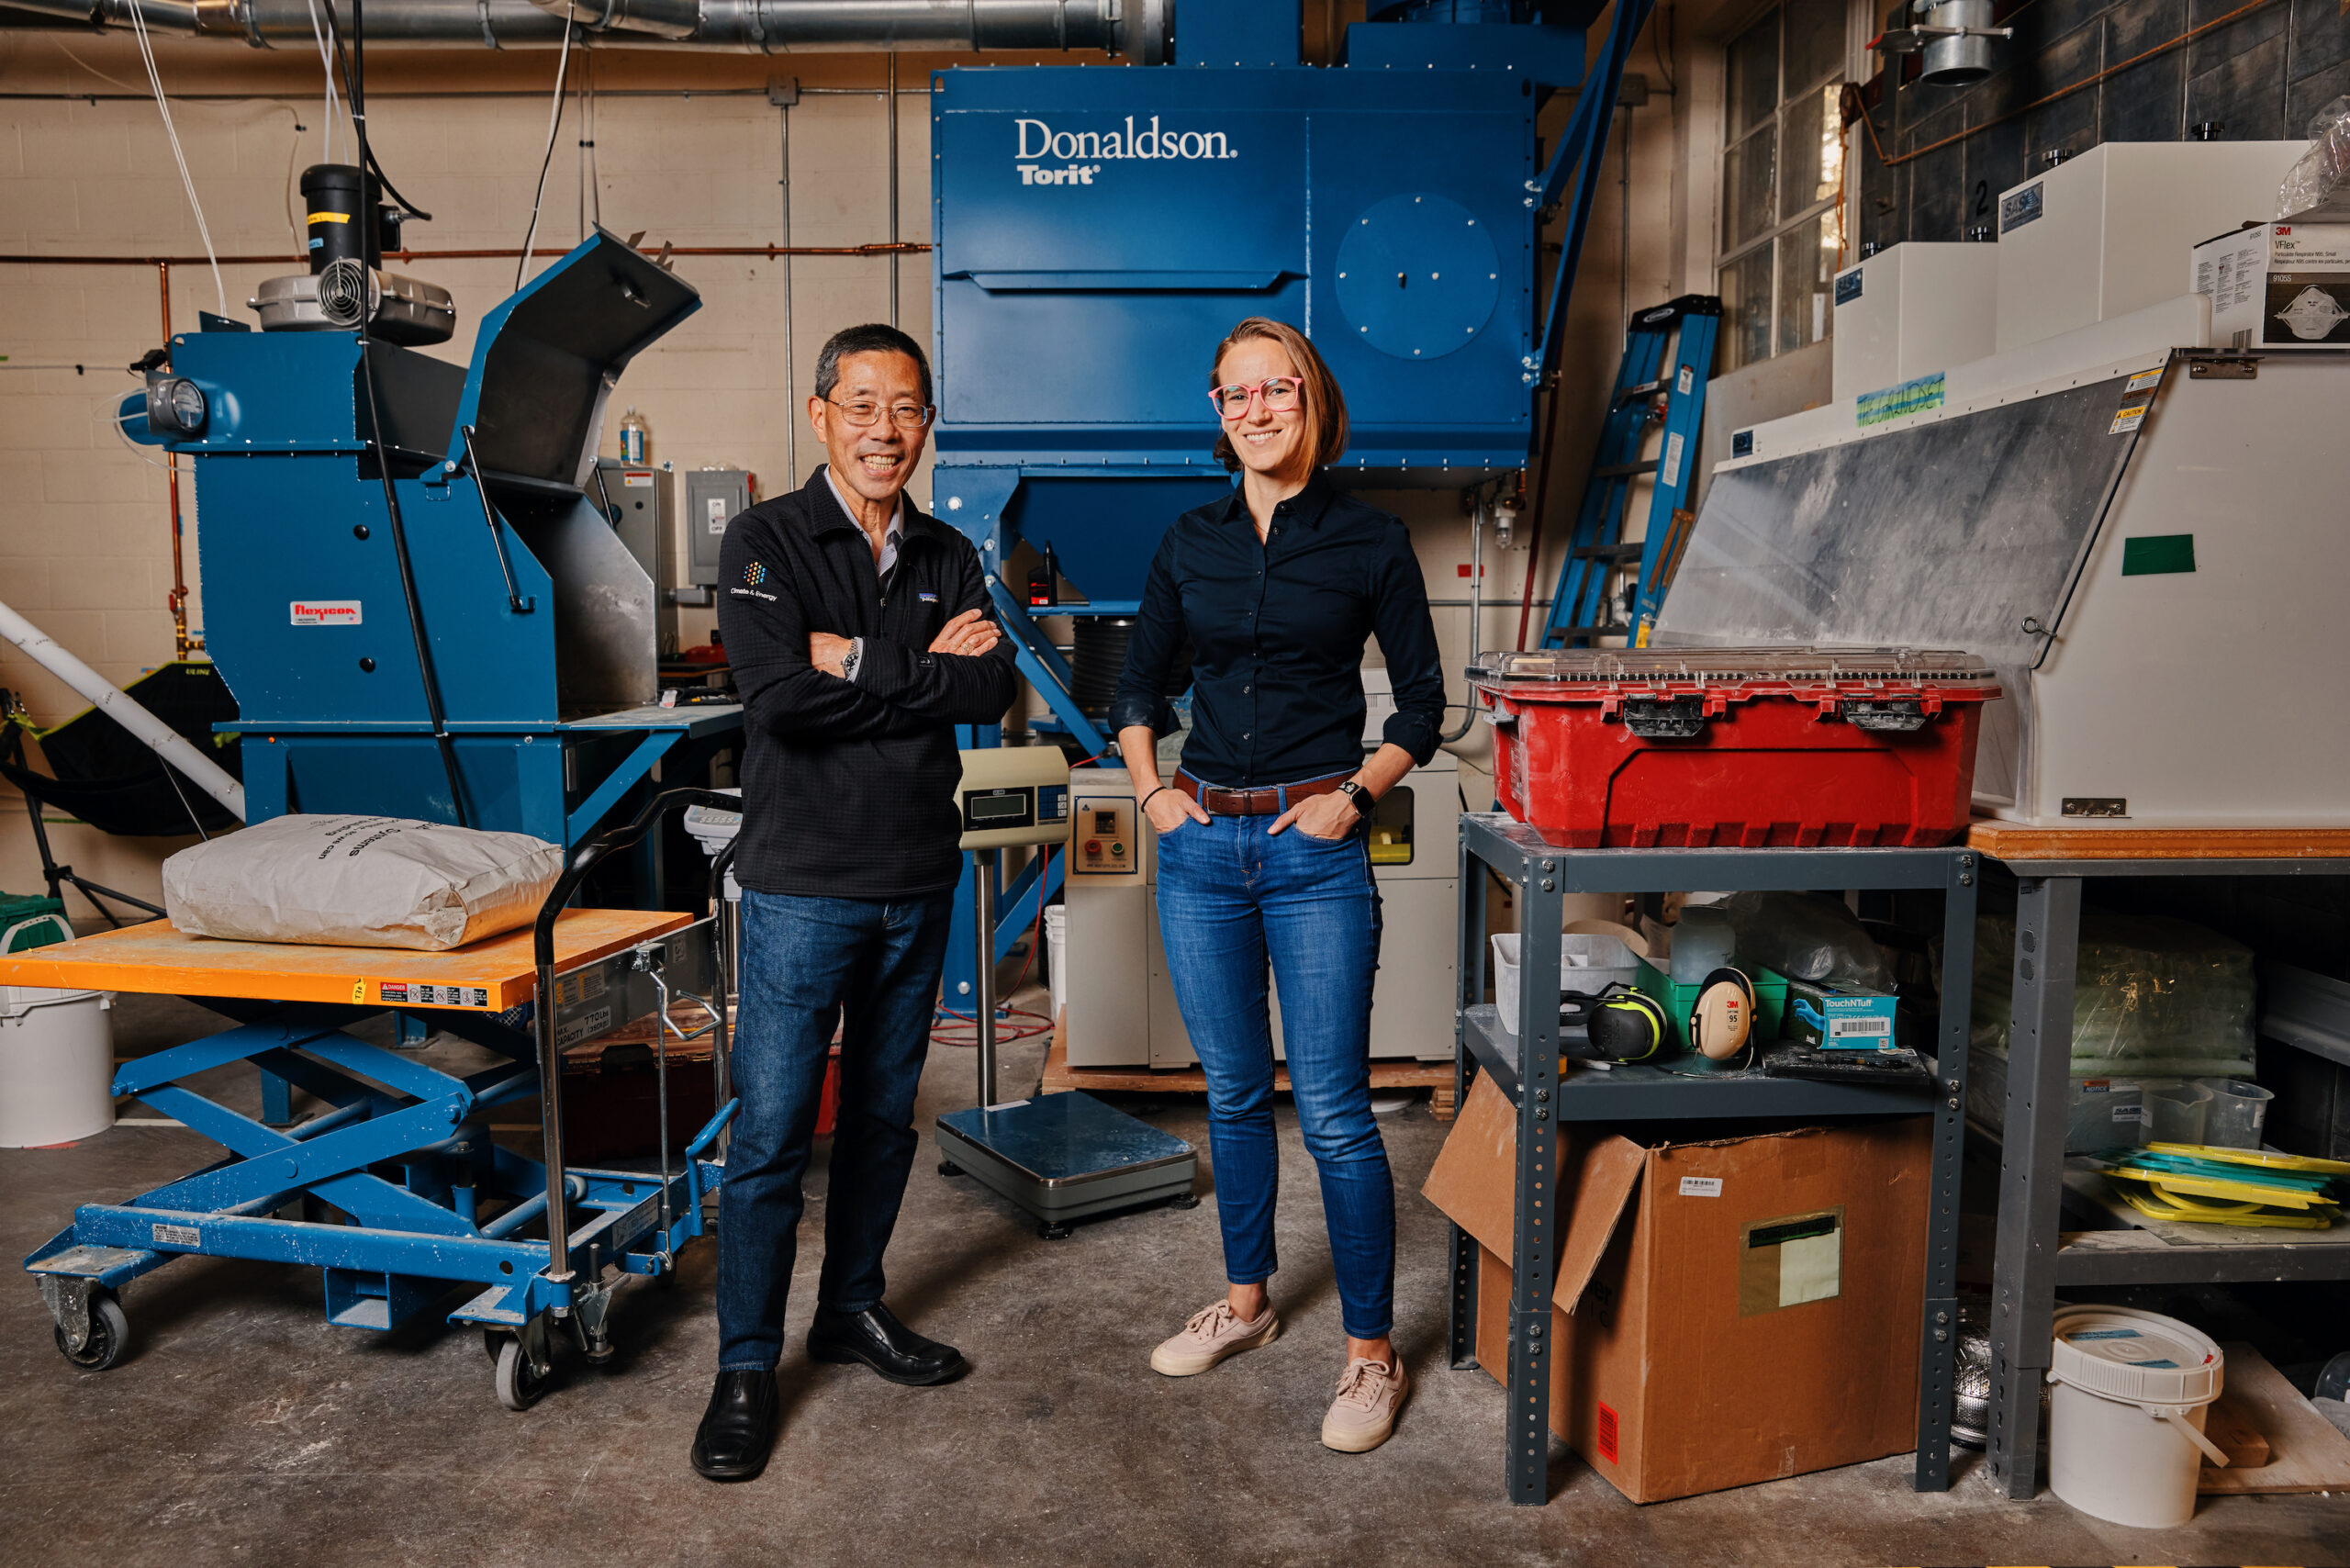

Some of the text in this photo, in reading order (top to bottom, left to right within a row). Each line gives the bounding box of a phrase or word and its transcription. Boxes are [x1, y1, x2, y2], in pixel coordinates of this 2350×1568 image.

[1976, 180, 1989, 217] 2
[2275, 226, 2291, 236] 3M
[2272, 274, 2292, 283] 9105S
[1857, 396, 1874, 427] THE
[755, 590, 778, 602] Energy
[185, 667, 210, 676] ULINE
[348, 827, 401, 857] Systems
[319, 844, 335, 860] can
[1727, 1001, 1739, 1009] 3M
[1729, 1014, 1738, 1023] 95
